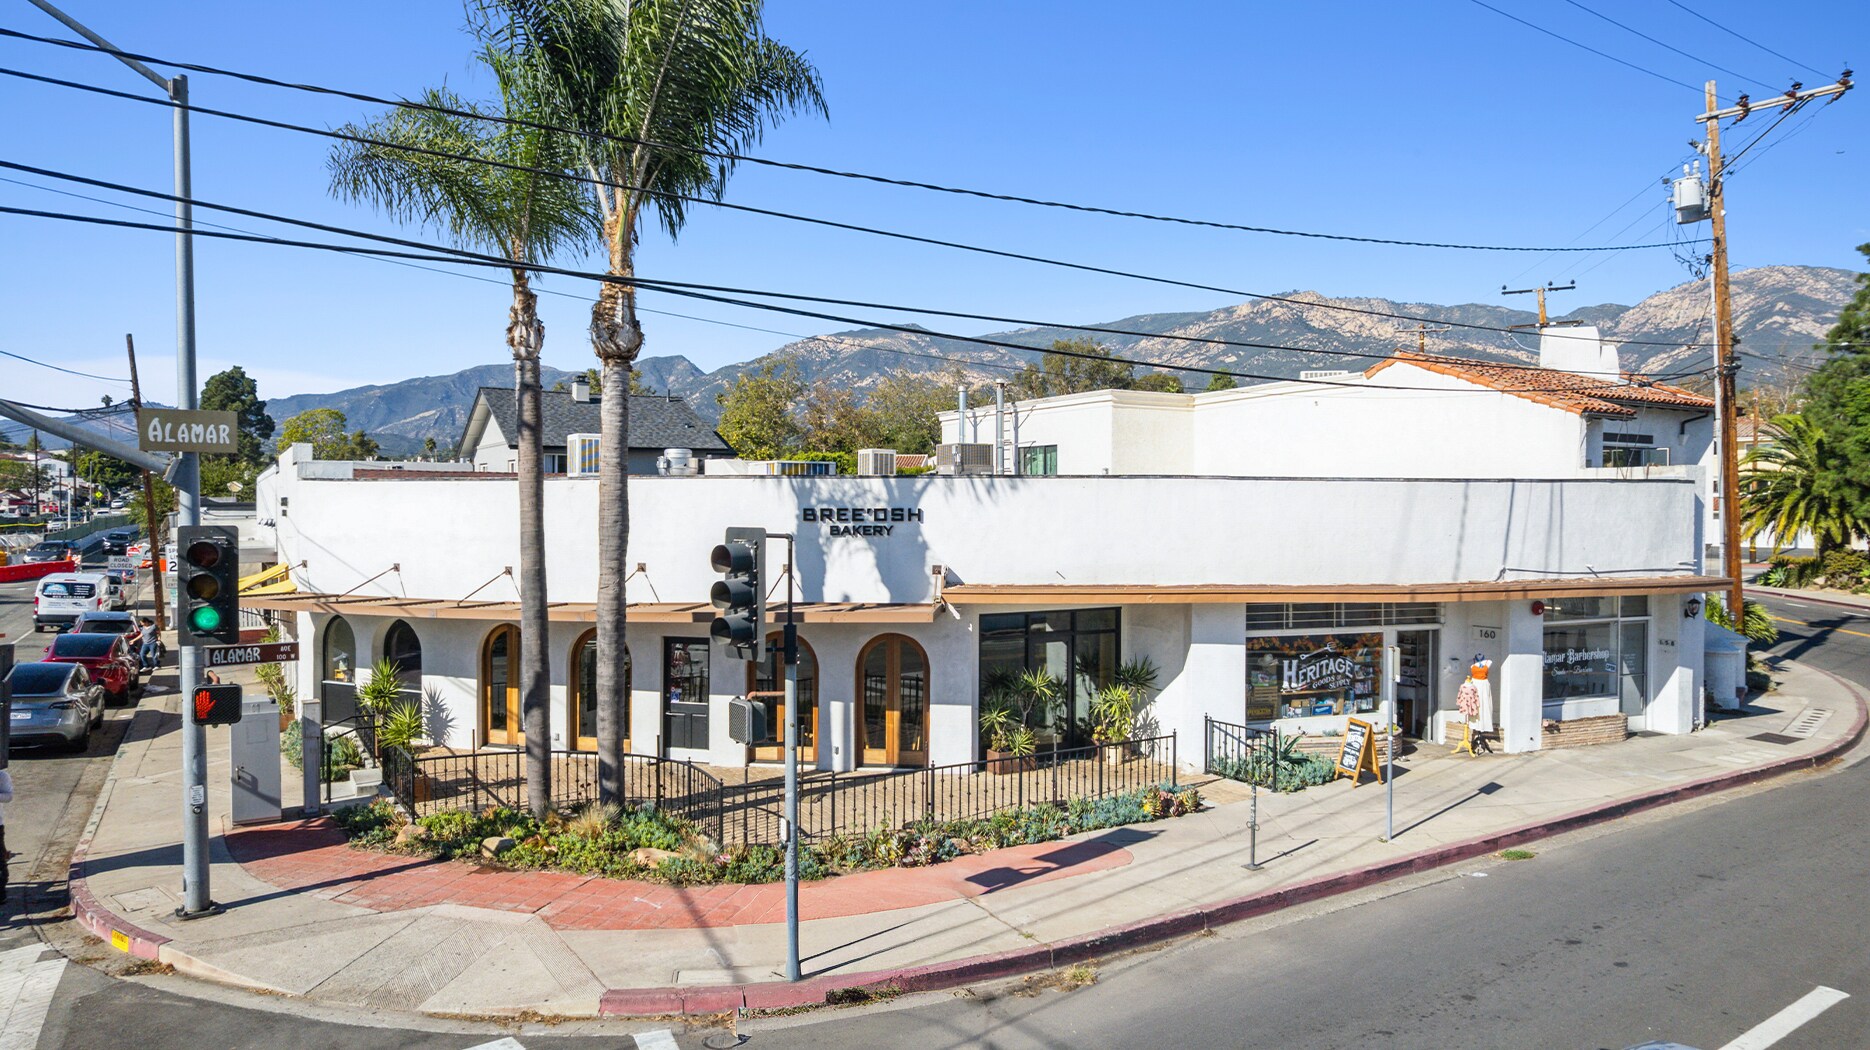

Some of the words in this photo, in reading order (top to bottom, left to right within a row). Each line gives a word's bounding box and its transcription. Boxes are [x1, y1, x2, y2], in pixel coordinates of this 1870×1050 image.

[147, 416, 230, 445] ALAMAR
[802, 507, 922, 523] BREE'OSH
[829, 524, 894, 537] BAKERY
[1479, 629, 1496, 640] 160
[212, 646, 261, 664] ALAMAR
[1281, 658, 1355, 689] HERITAGE
[1312, 675, 1335, 689] GOODS
[1328, 679, 1351, 690] SUPPLY
